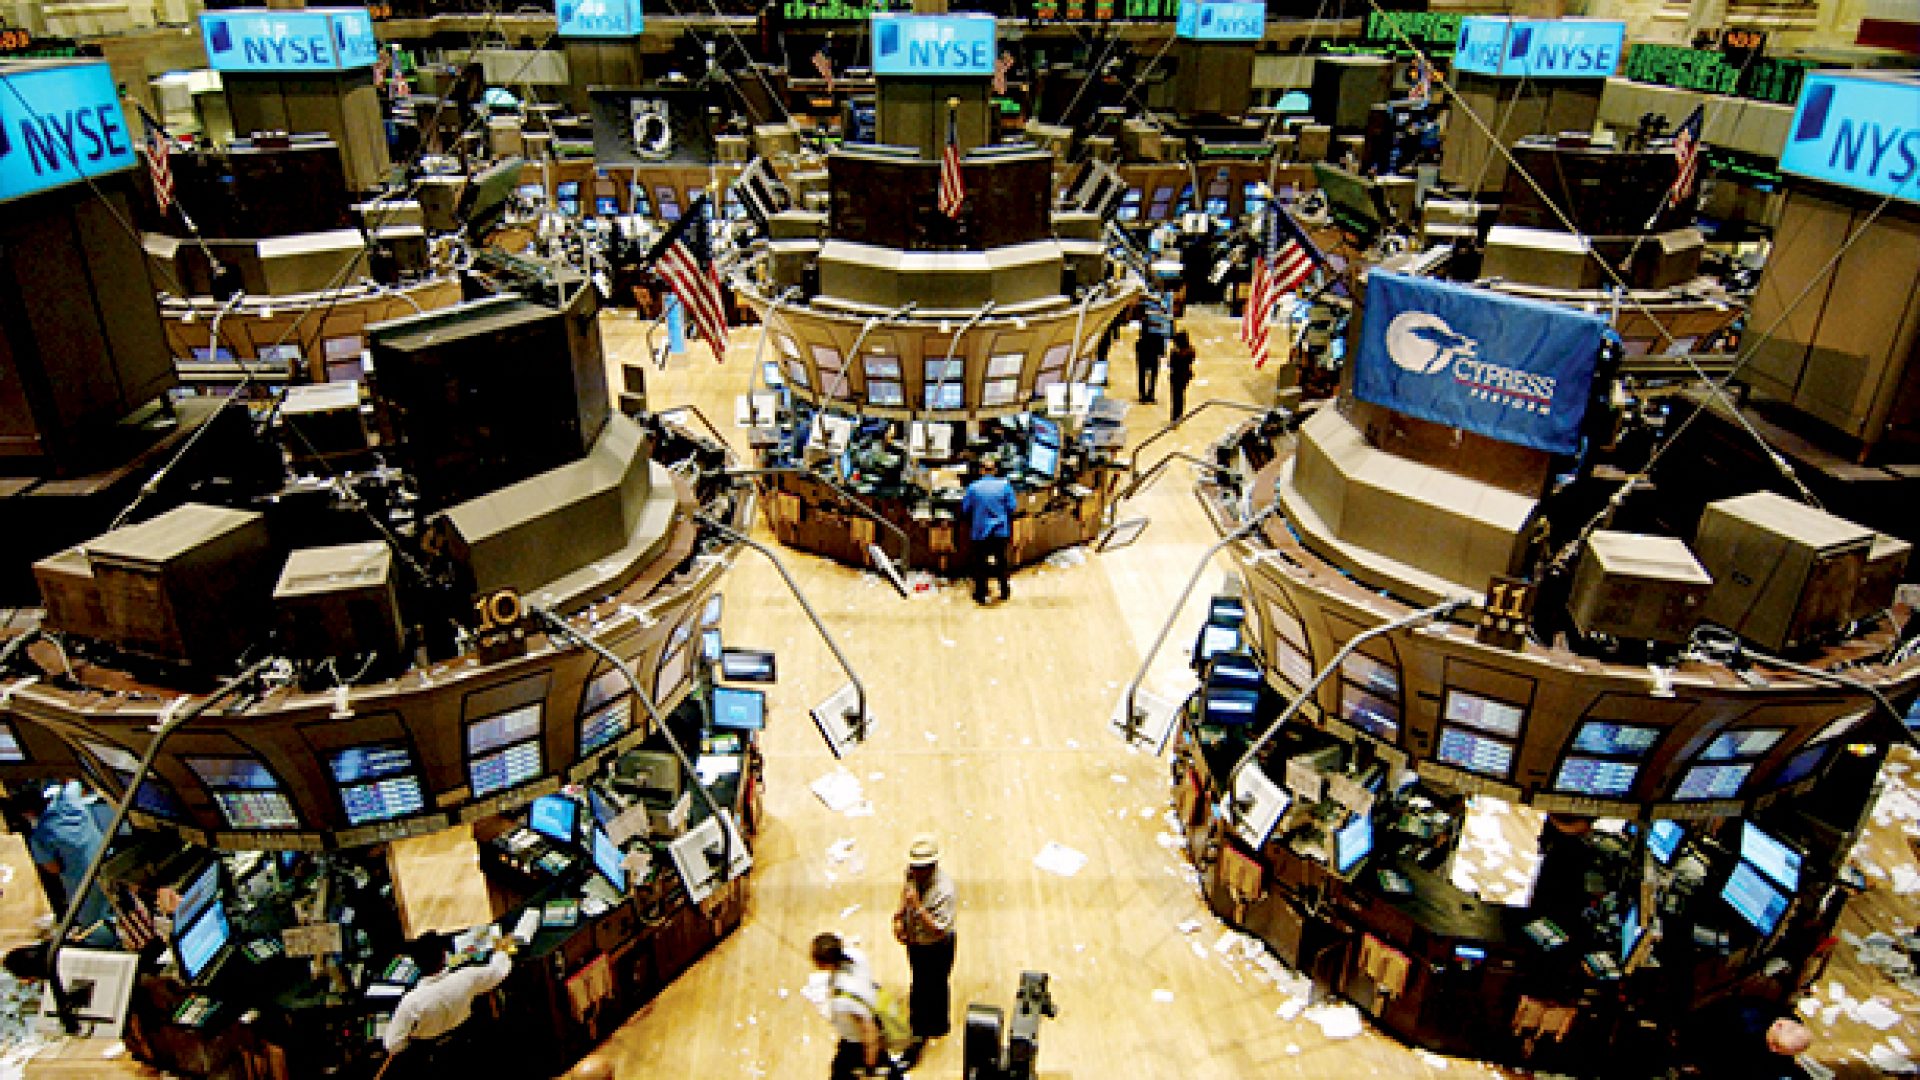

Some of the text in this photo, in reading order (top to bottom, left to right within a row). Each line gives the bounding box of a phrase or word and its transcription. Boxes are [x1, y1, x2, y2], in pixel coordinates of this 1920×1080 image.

[243, 35, 330, 63] NYSE
[908, 40, 986, 67] NYSE
[1535, 43, 1611, 70] NYSE
[19, 103, 127, 176] NYSE
[1828, 117, 1920, 189] NYS
[1453, 358, 1557, 399] CYPRESS
[474, 589, 521, 631] 10
[1487, 583, 1526, 619] 11
